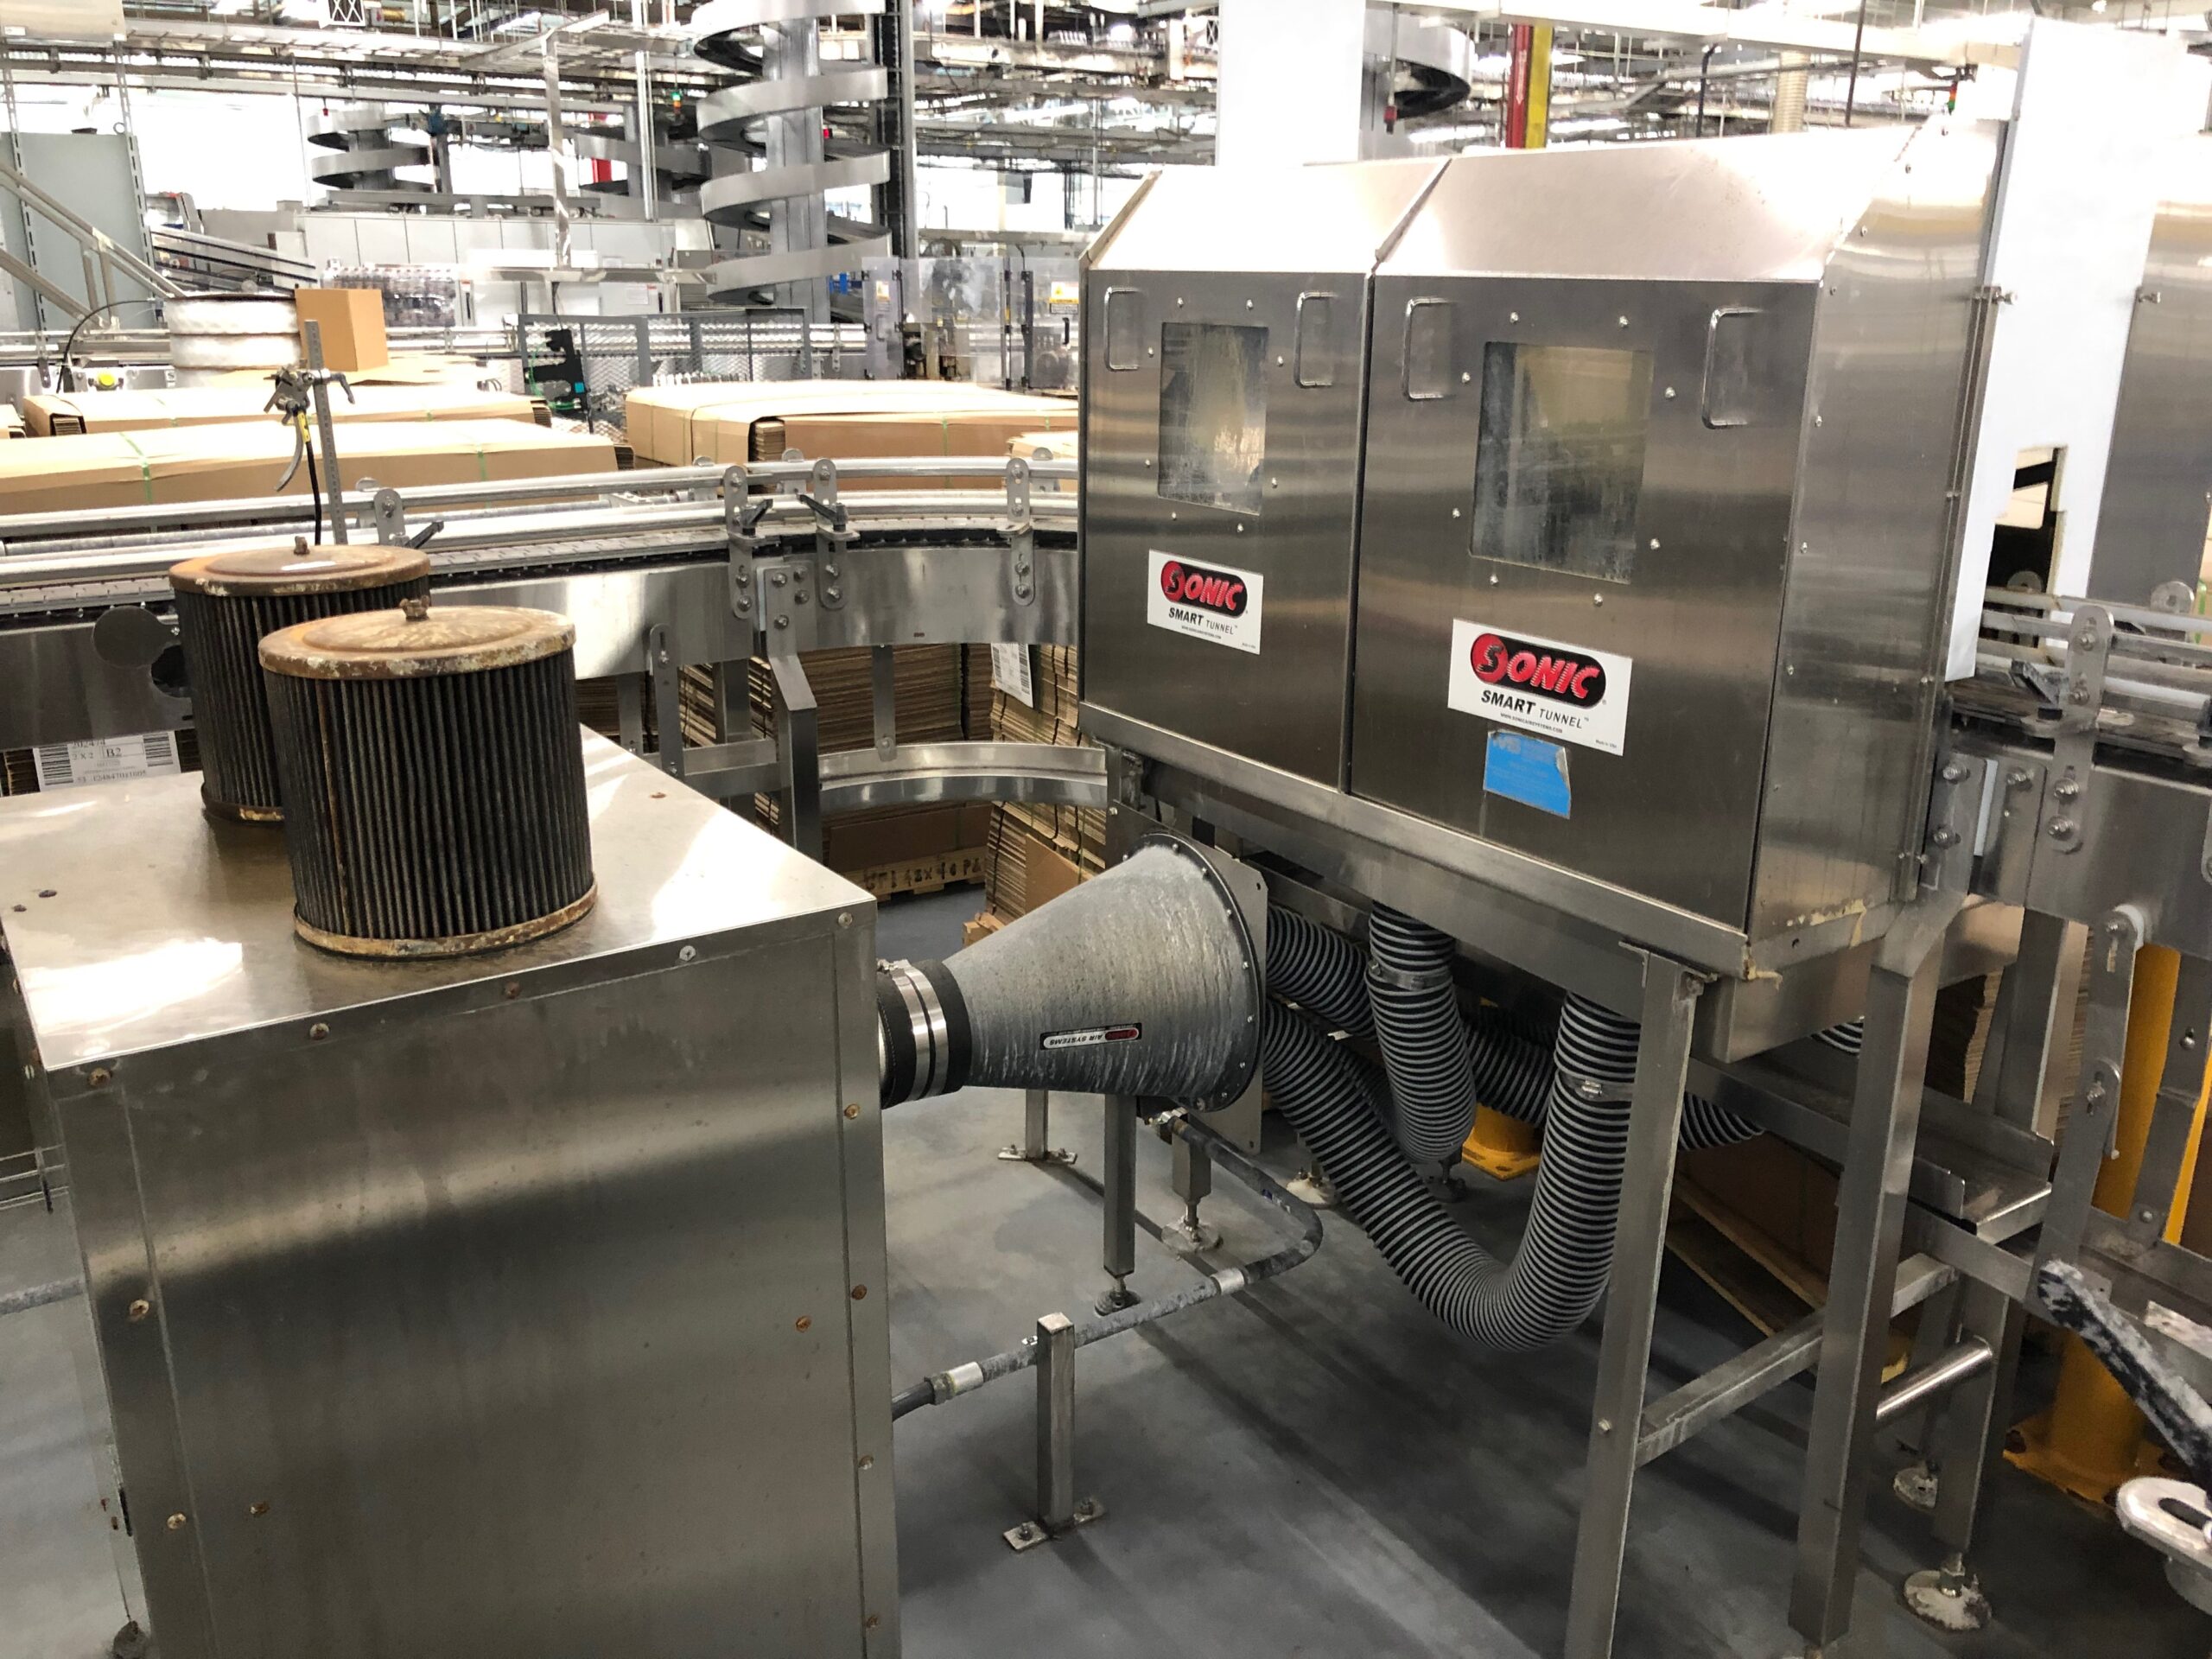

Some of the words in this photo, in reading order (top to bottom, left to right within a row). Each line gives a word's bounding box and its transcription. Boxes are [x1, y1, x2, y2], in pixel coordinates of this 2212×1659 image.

[1164, 567, 1243, 611] SONIC
[1168, 607, 1204, 626] SMART
[1206, 620, 1234, 635] TUNNEL
[1475, 644, 1600, 699] SONIC
[1481, 690, 1536, 715] SMART
[1540, 709, 1583, 729] TUNNEL
[105, 747, 123, 758] B2
[1049, 1035, 1088, 1046] SYSTEMS
